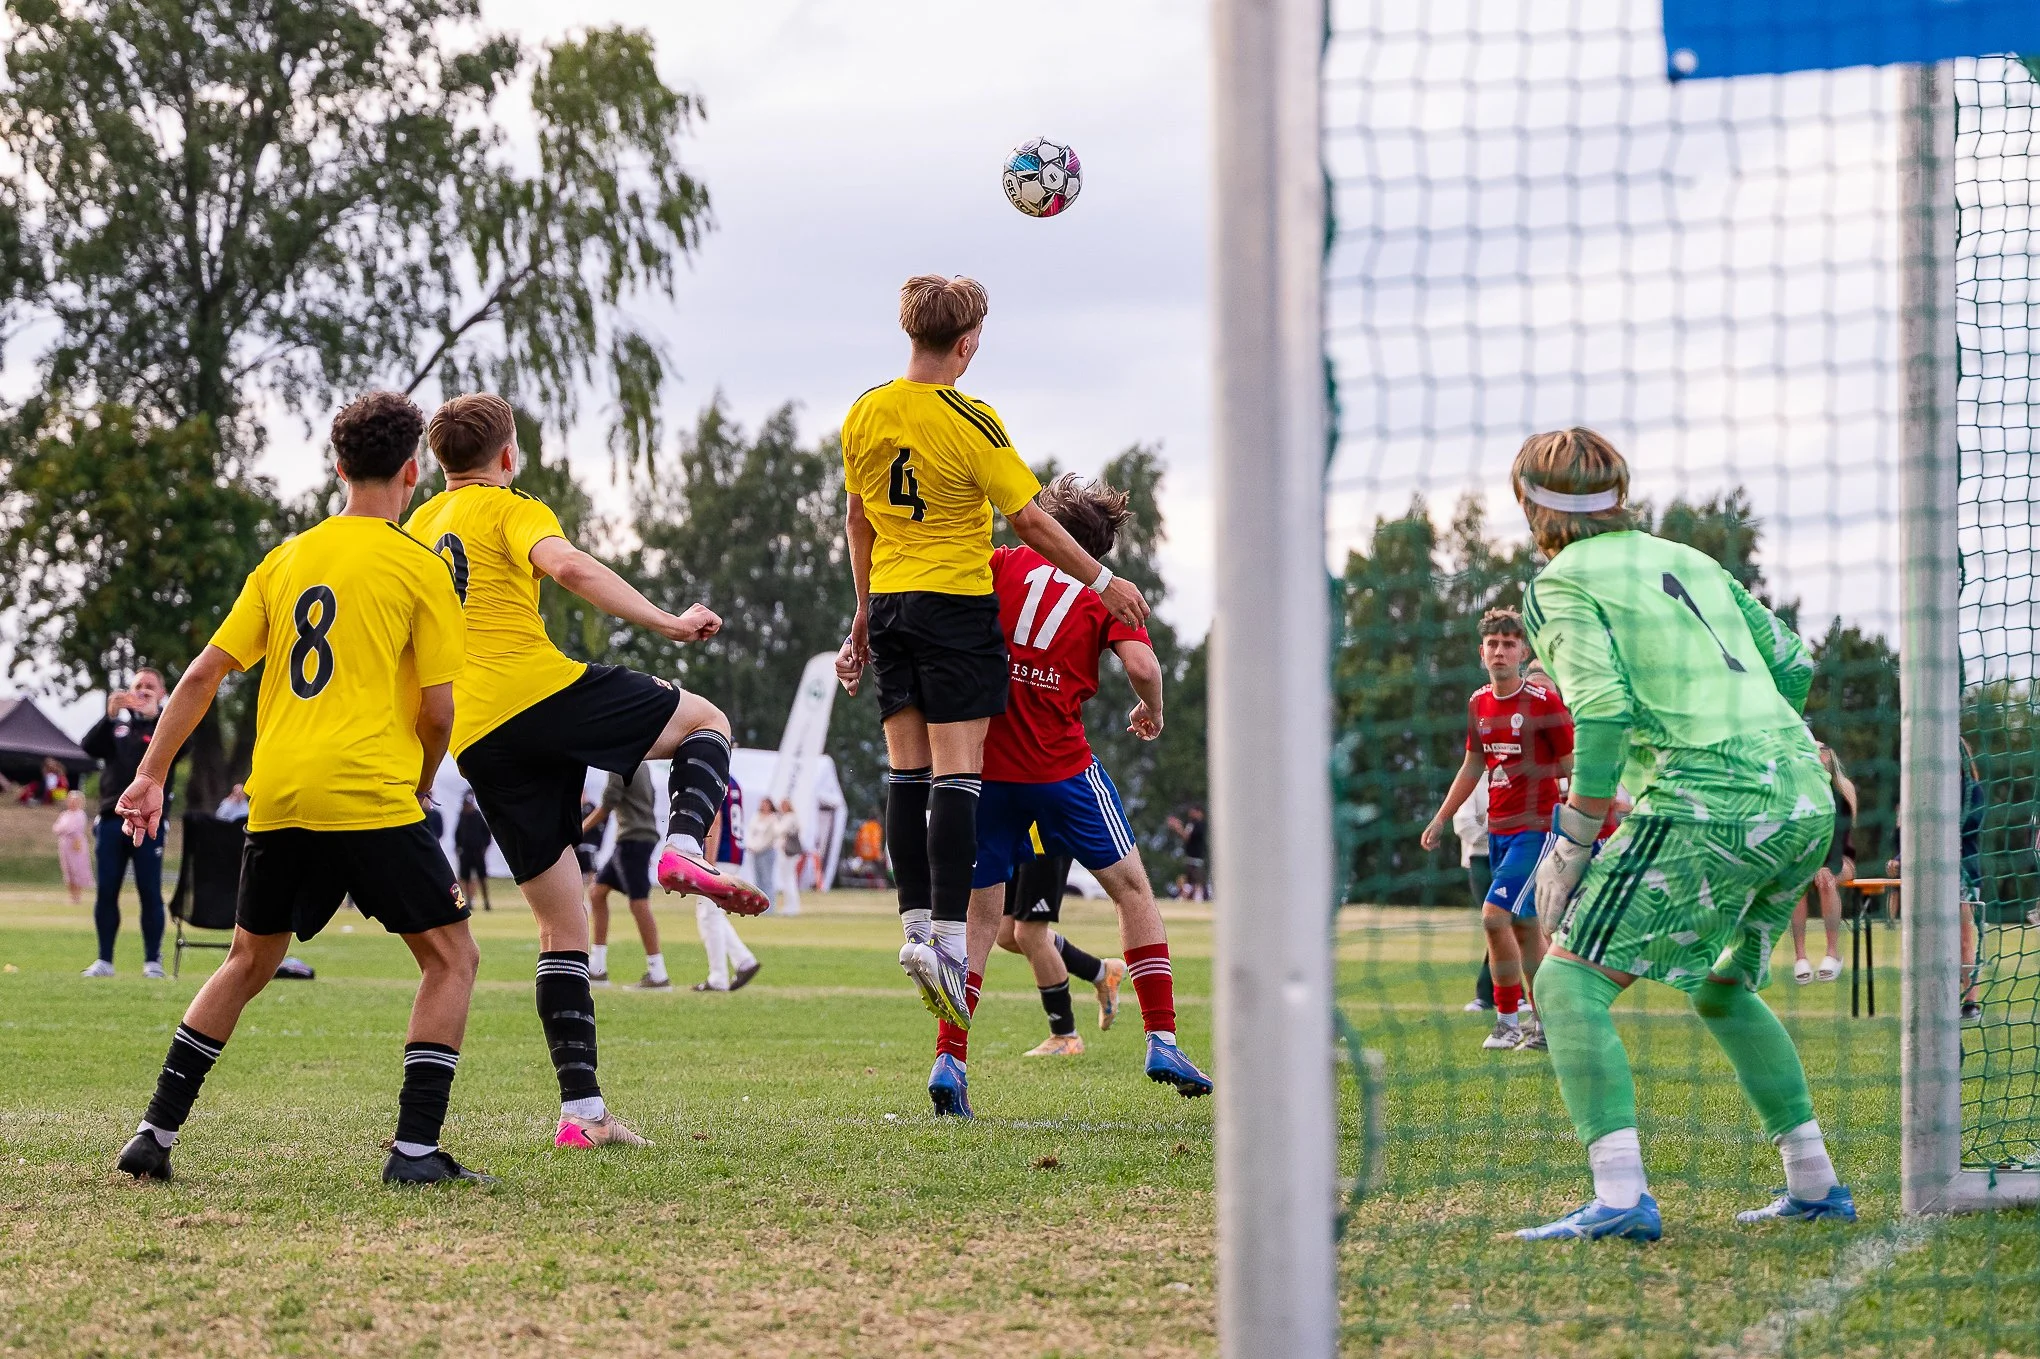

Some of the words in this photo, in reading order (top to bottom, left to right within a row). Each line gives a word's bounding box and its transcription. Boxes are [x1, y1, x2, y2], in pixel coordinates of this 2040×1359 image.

[1005, 179, 1035, 214] SELECT
[888, 447, 928, 522] 4
[289, 584, 338, 700] 8
[1013, 564, 1086, 651] 17
[1661, 571, 1748, 672] 1
[1031, 668, 1060, 684] PLÅT
